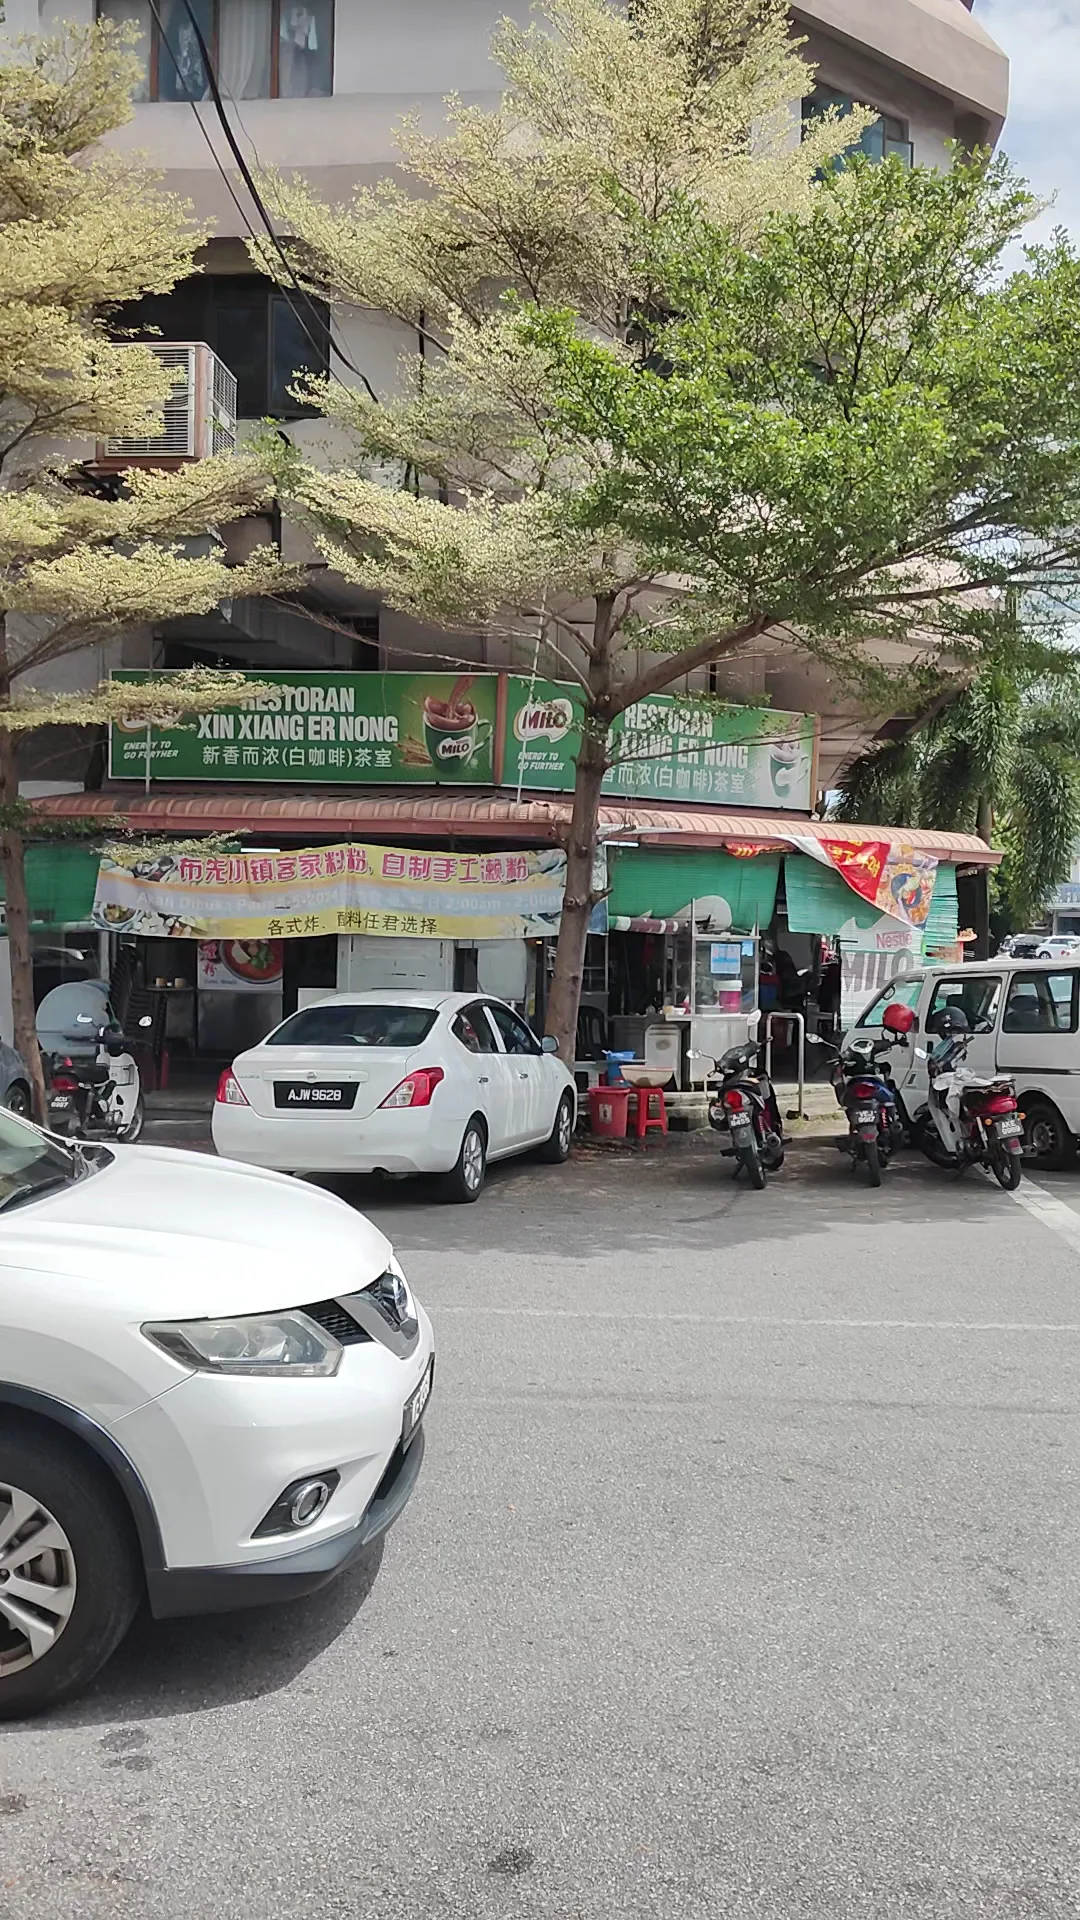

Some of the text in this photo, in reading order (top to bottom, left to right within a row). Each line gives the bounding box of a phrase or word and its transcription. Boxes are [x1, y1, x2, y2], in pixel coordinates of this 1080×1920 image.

[522, 710, 568, 729] MILO
[197, 714, 235, 740] XIN
[238, 714, 304, 741] XIANG
[308, 715, 336, 741] ER
[339, 716, 399, 742] NONG
[123, 740, 172, 750] ENERY TO
[441, 743, 470, 755] MILO
[123, 751, 137, 760] GO
[202, 745, 393, 768] 新香而浓(白咖啡)茶室
[549, 752, 559, 761] TO
[678, 737, 700, 764] ER
[704, 741, 748, 769] NONG
[530, 762, 565, 771] FURTHER
[602, 762, 746, 794] 香而浓(白咖啡)茶室
[287, 1089, 341, 1101] AJW 9628
